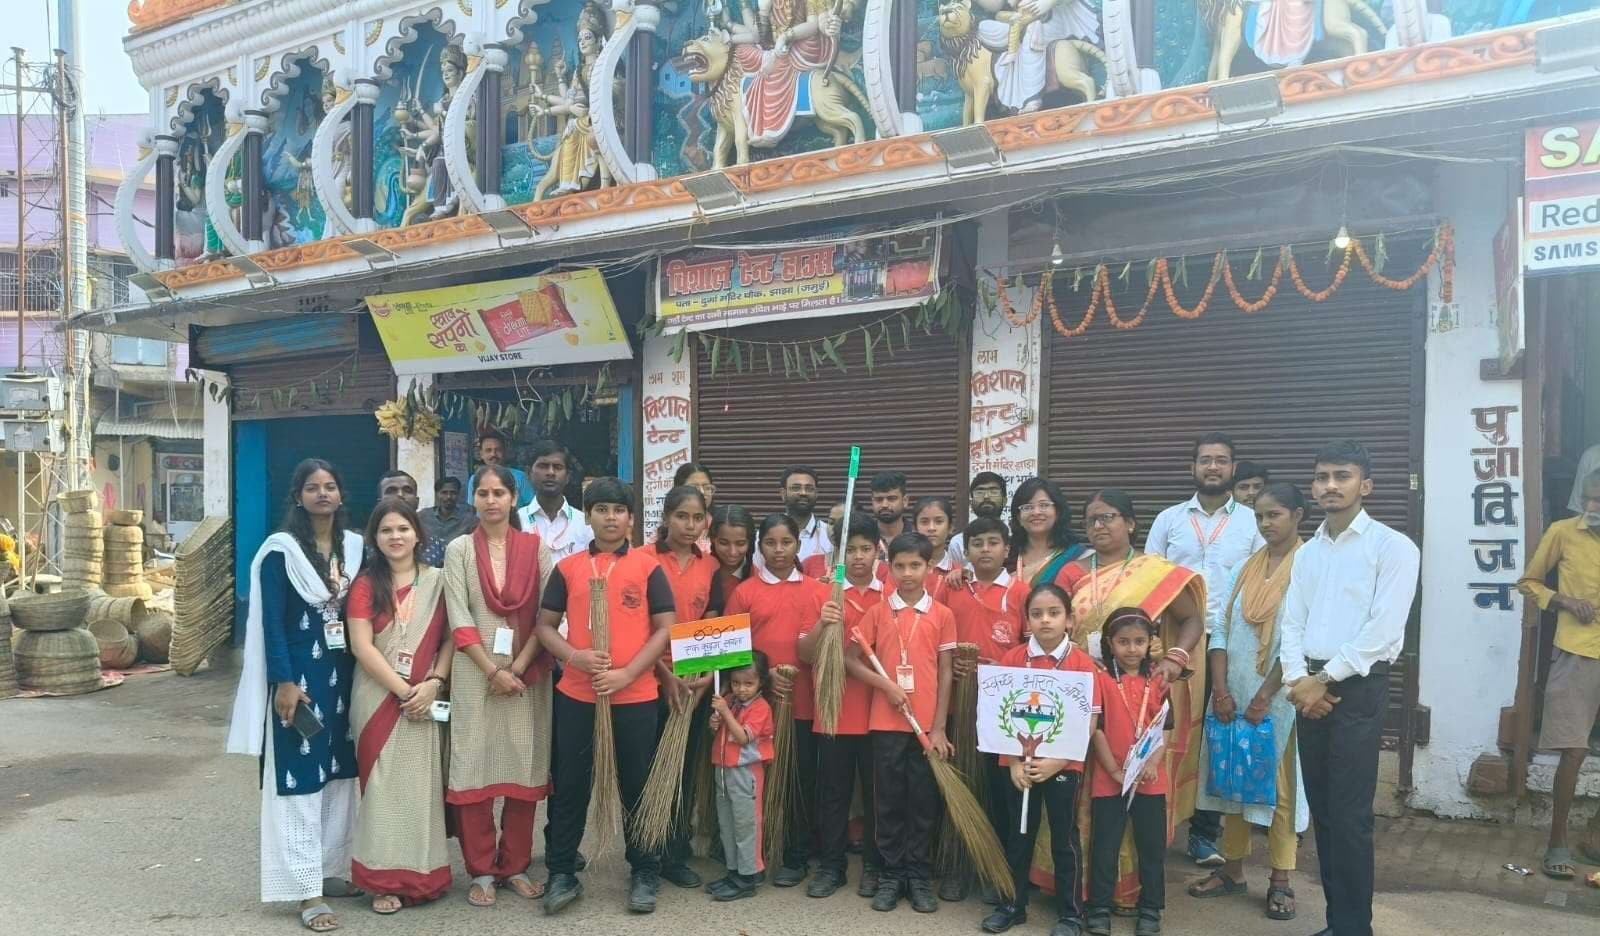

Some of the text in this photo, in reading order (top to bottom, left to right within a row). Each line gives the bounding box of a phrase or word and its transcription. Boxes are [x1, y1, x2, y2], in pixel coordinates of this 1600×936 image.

[1534, 241, 1598, 262] SAMS
[667, 258, 734, 297] विशाल
[781, 244, 837, 282] हाउस
[478, 352, 522, 363] VIJAY STORE
[972, 369, 1027, 397] विशाल
[644, 395, 691, 424] विशाल
[1023, 674, 1059, 691] भारत
